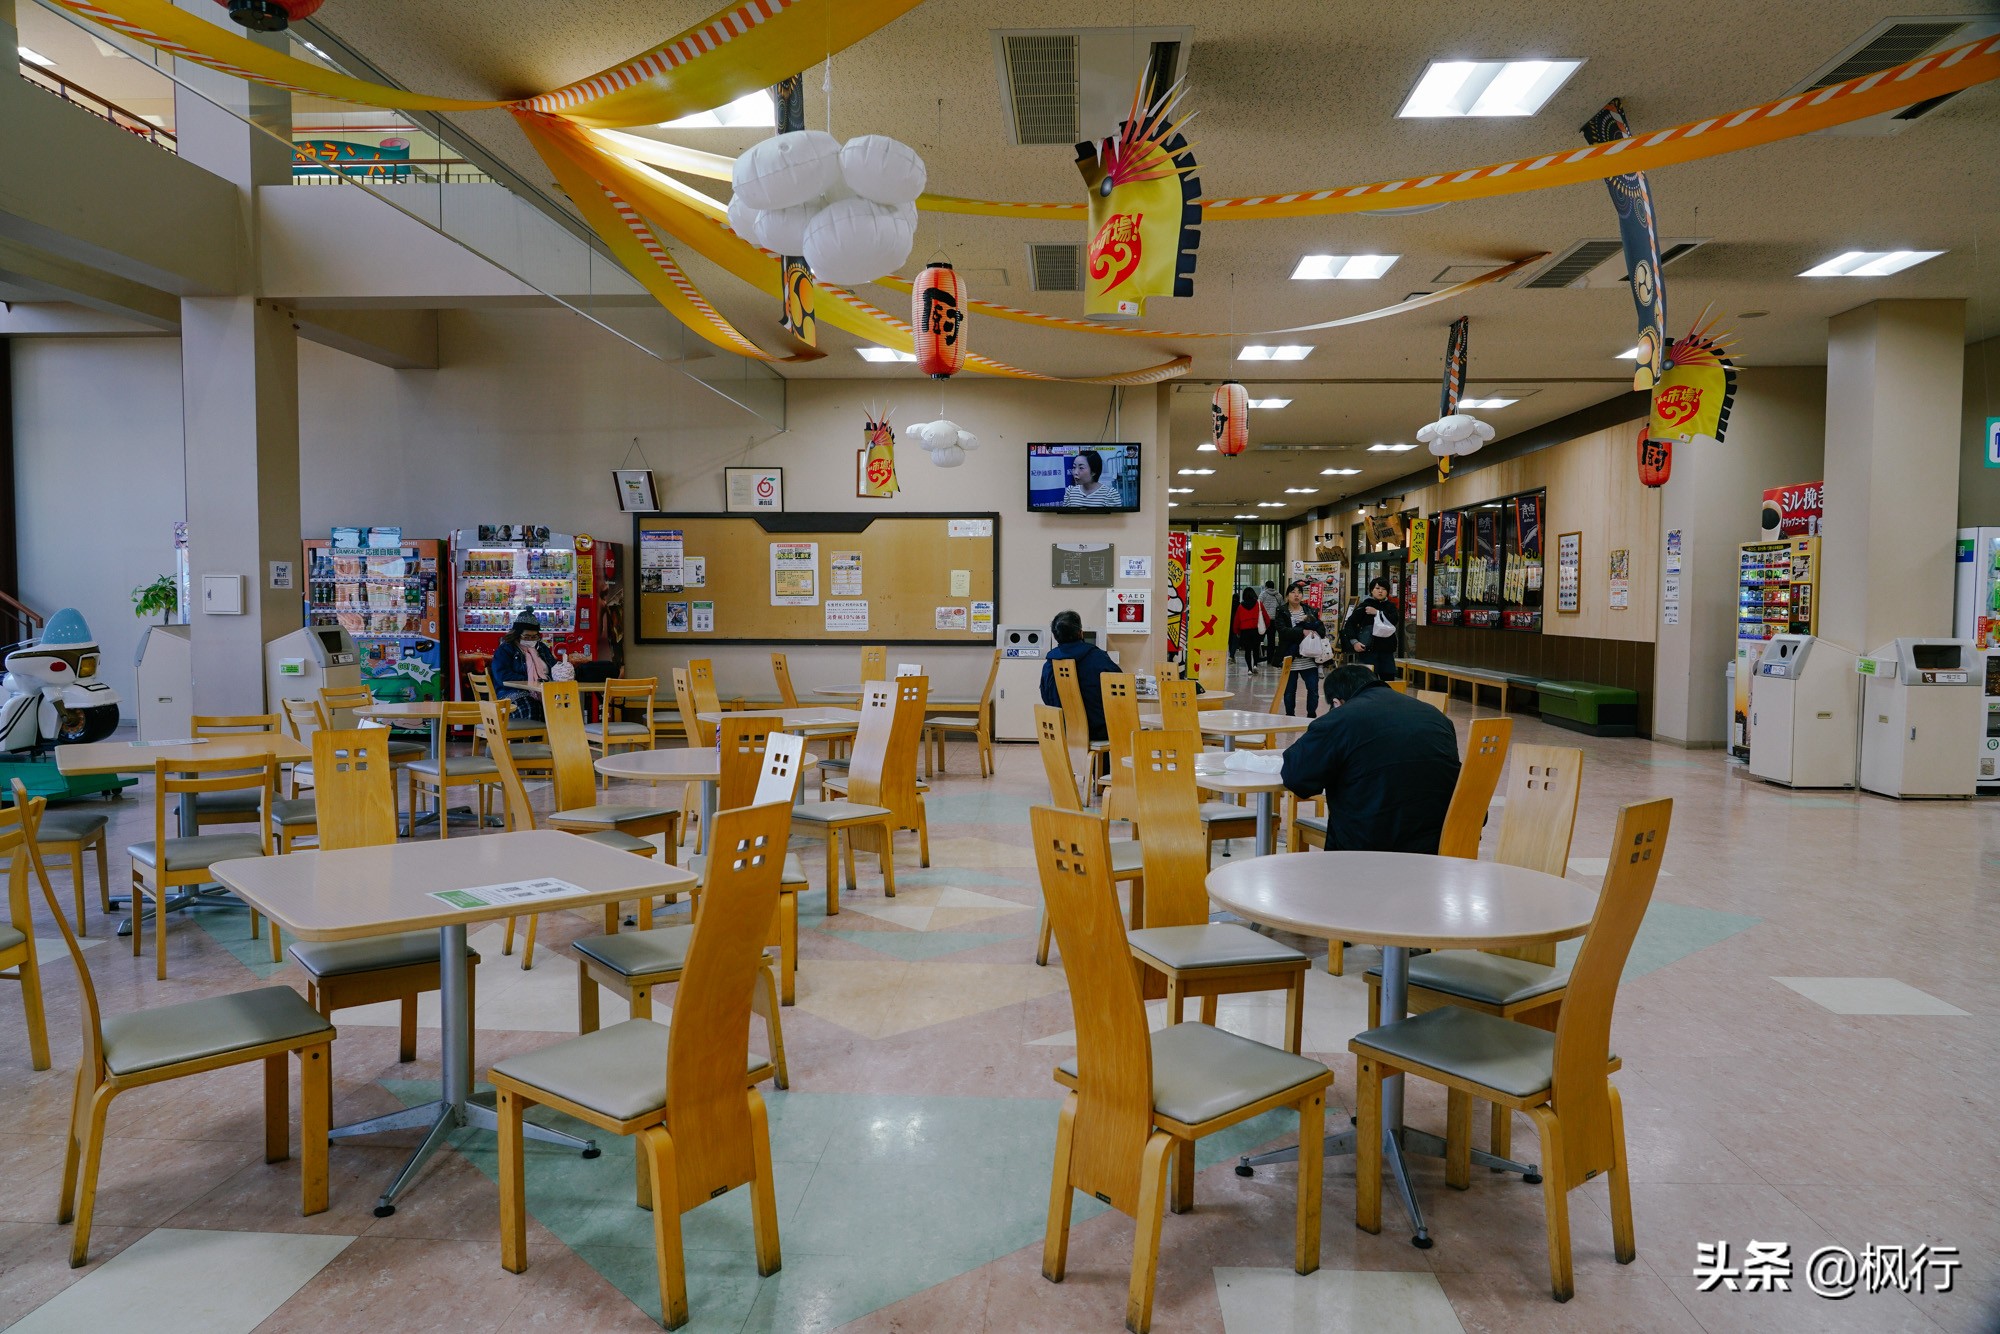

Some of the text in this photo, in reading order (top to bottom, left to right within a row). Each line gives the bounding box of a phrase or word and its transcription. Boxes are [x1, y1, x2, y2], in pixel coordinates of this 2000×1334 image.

[922, 286, 964, 346] 厨
[398, 661, 410, 671] GO!
[410, 663, 420, 673] TO
